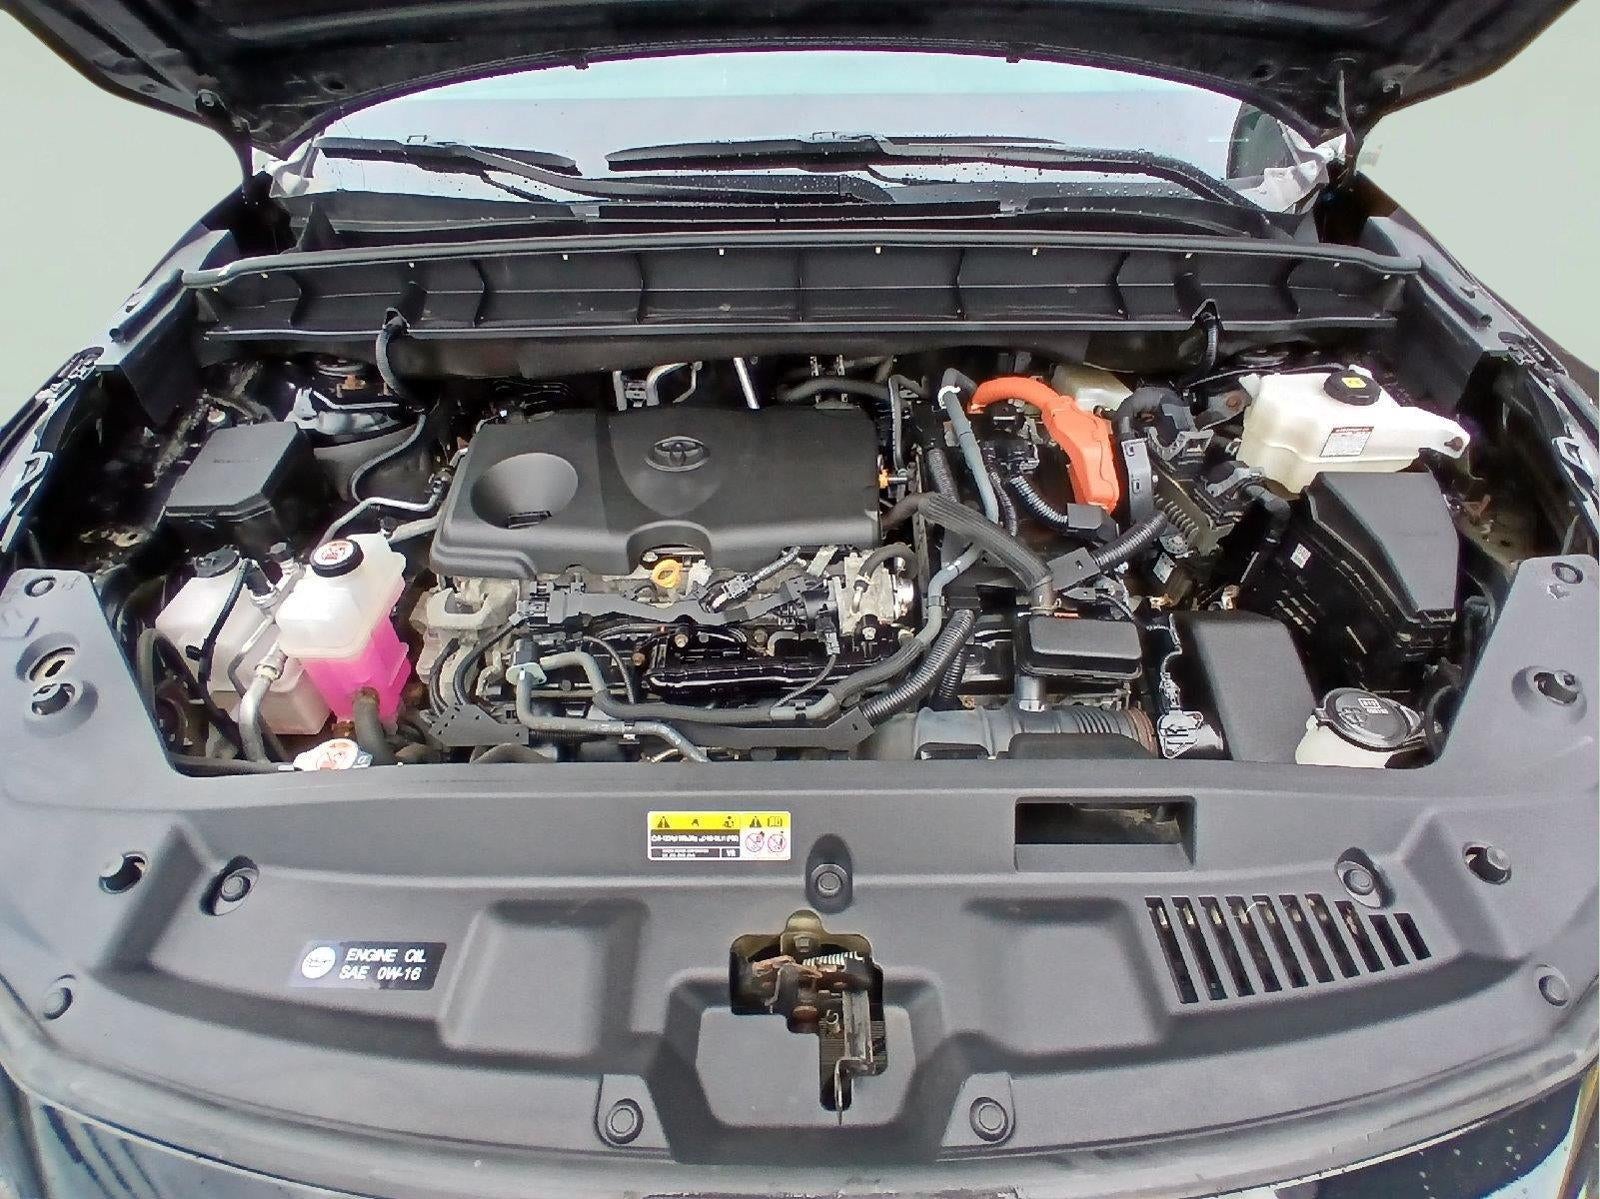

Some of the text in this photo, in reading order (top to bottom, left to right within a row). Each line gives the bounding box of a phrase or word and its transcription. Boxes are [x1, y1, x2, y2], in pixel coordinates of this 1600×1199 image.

[345, 948, 426, 962] ENGINE OIL
[339, 965, 370, 979] SAE
